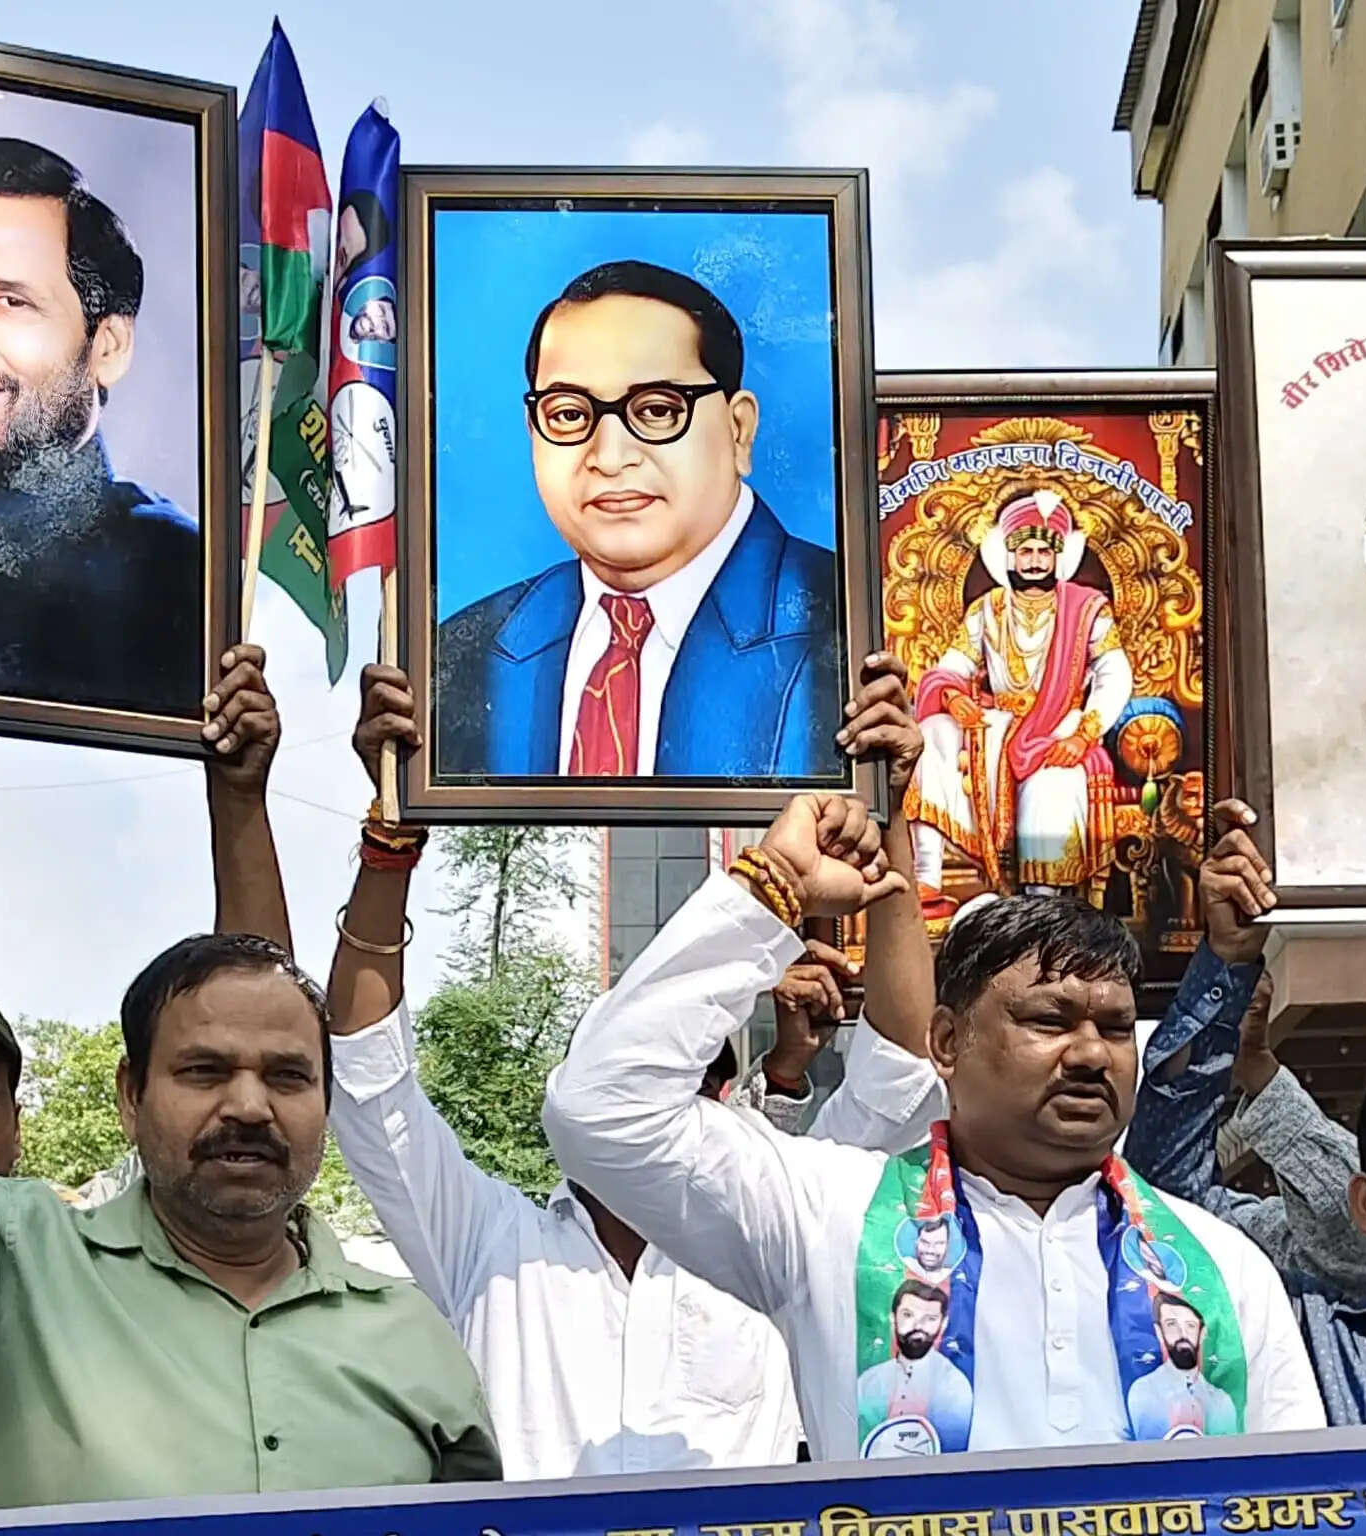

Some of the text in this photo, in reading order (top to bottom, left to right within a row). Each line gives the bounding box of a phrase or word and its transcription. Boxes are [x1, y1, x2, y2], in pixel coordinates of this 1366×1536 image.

[1280, 372, 1321, 411] वीर
[948, 445, 1053, 473] महाराजा
[1056, 440, 1136, 494] बिजली
[1138, 479, 1193, 534] पासी
[1222, 1489, 1355, 1532] अमर
